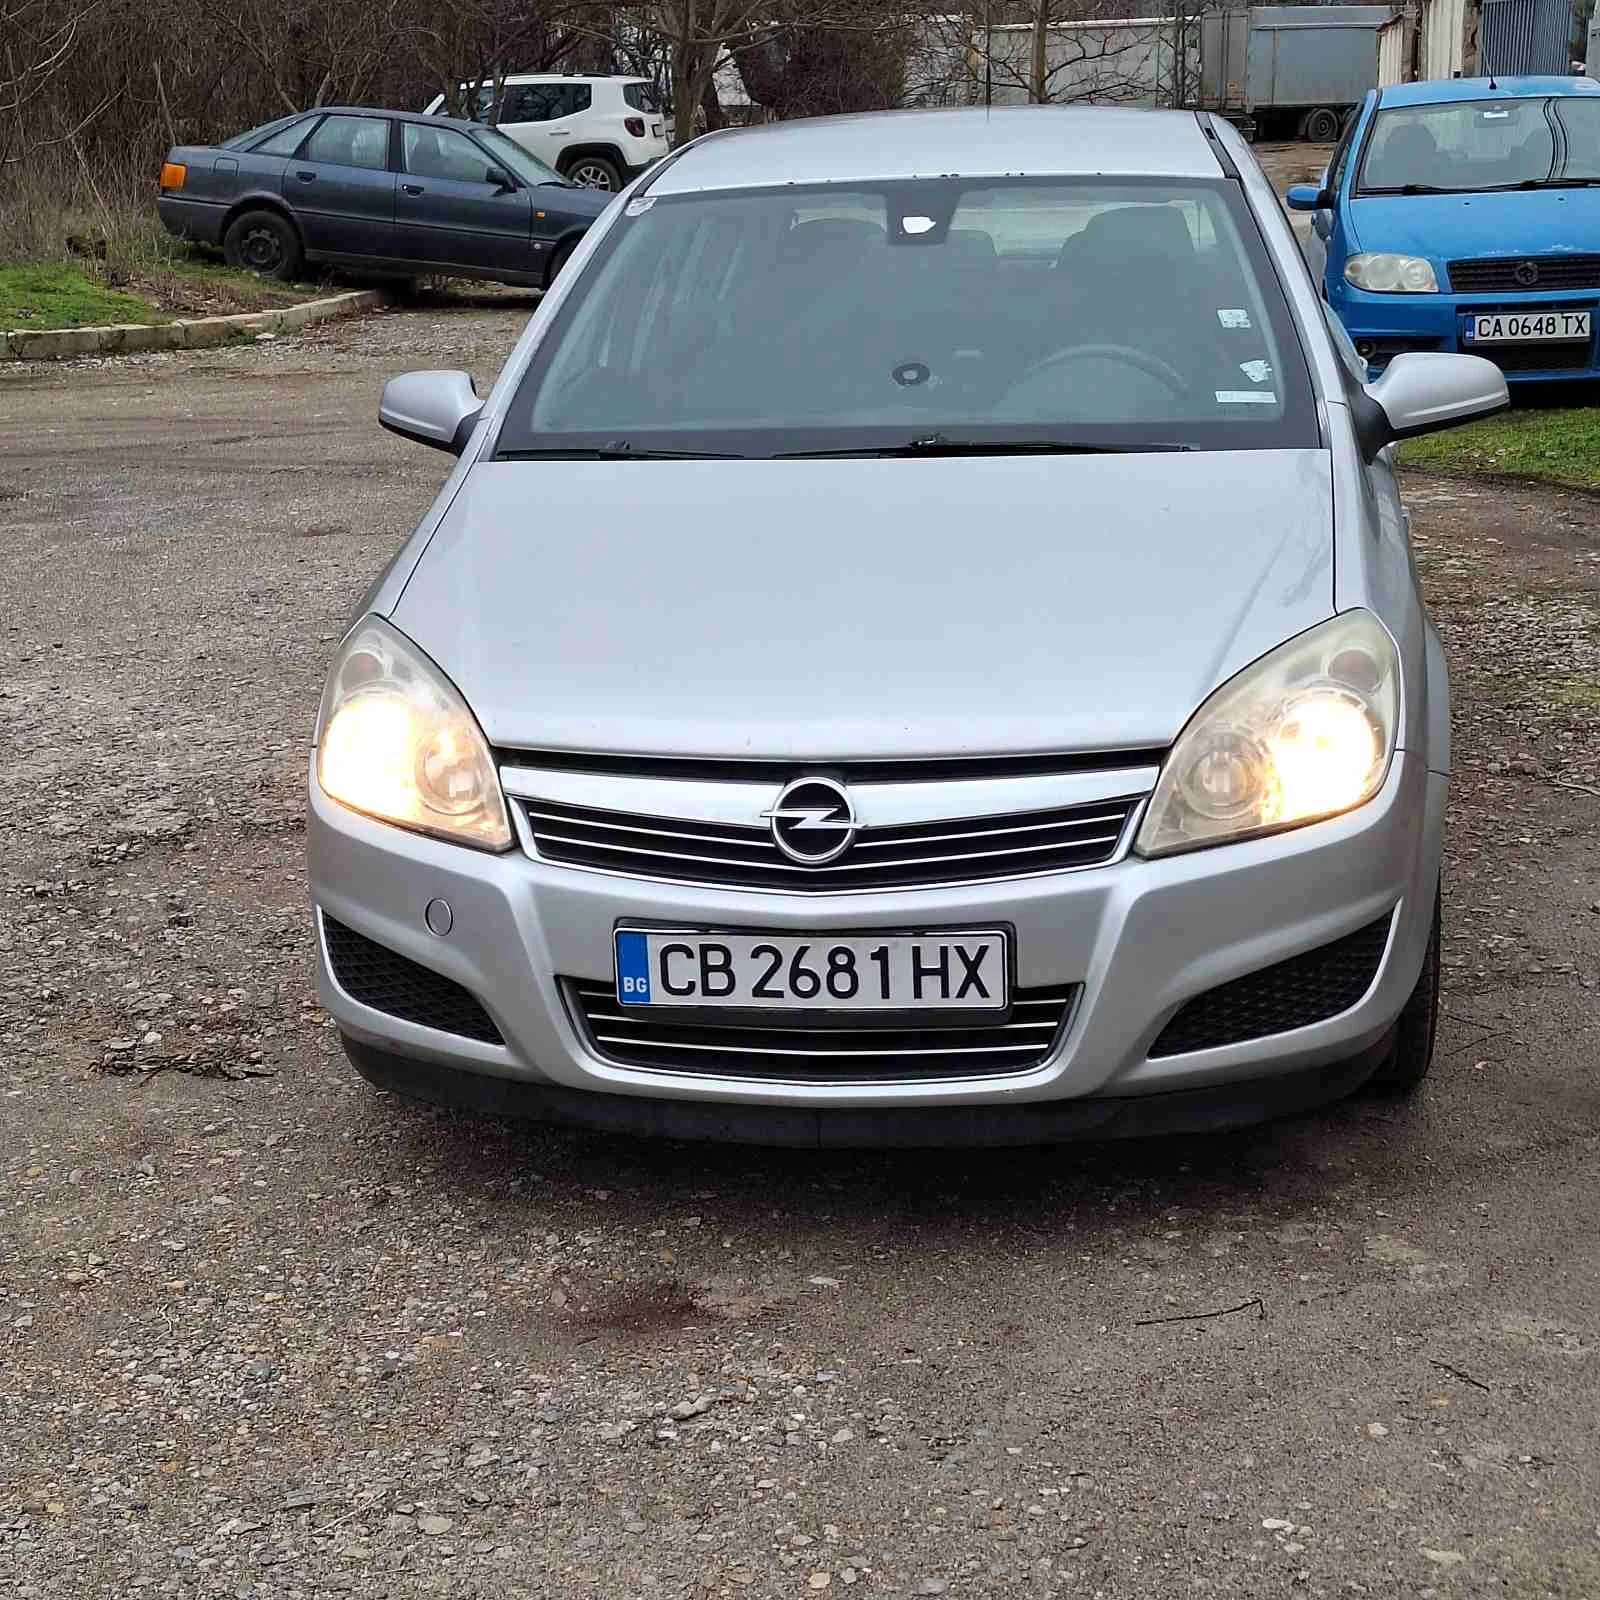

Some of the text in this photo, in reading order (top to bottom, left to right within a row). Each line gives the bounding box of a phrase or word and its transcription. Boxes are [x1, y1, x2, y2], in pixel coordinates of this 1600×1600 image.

[1478, 315, 1587, 337] CA 0648 TX
[659, 943, 990, 999] CB 2681 HX
[623, 976, 648, 993] BG
